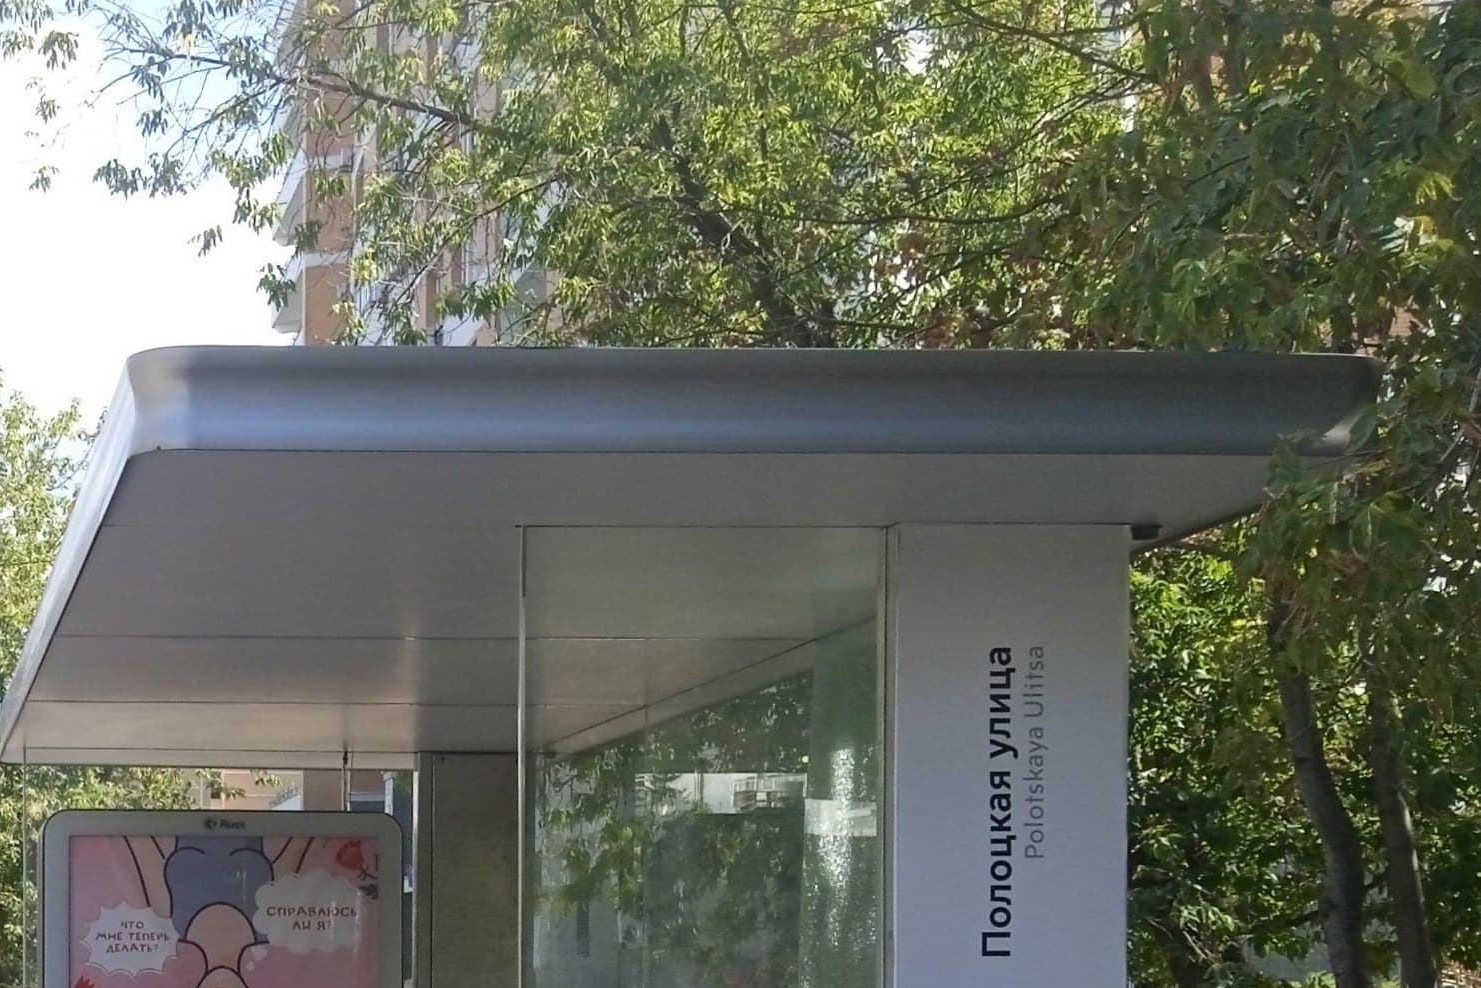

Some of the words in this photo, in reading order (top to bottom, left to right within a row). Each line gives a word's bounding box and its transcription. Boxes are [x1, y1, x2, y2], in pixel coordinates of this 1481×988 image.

[989, 646, 1018, 759] улица
[1022, 645, 1045, 718] Ulitsa
[1022, 726, 1049, 859] Polotskaya
[981, 769, 1017, 957] Полоцкая
[96, 931, 123, 941] МНЕ
[128, 931, 170, 941] ТЕПЕРЬ
[121, 921, 145, 930] ЧТО
[293, 920, 312, 931] ЛИ
[106, 943, 160, 954] ДЕЛАТЬ?
